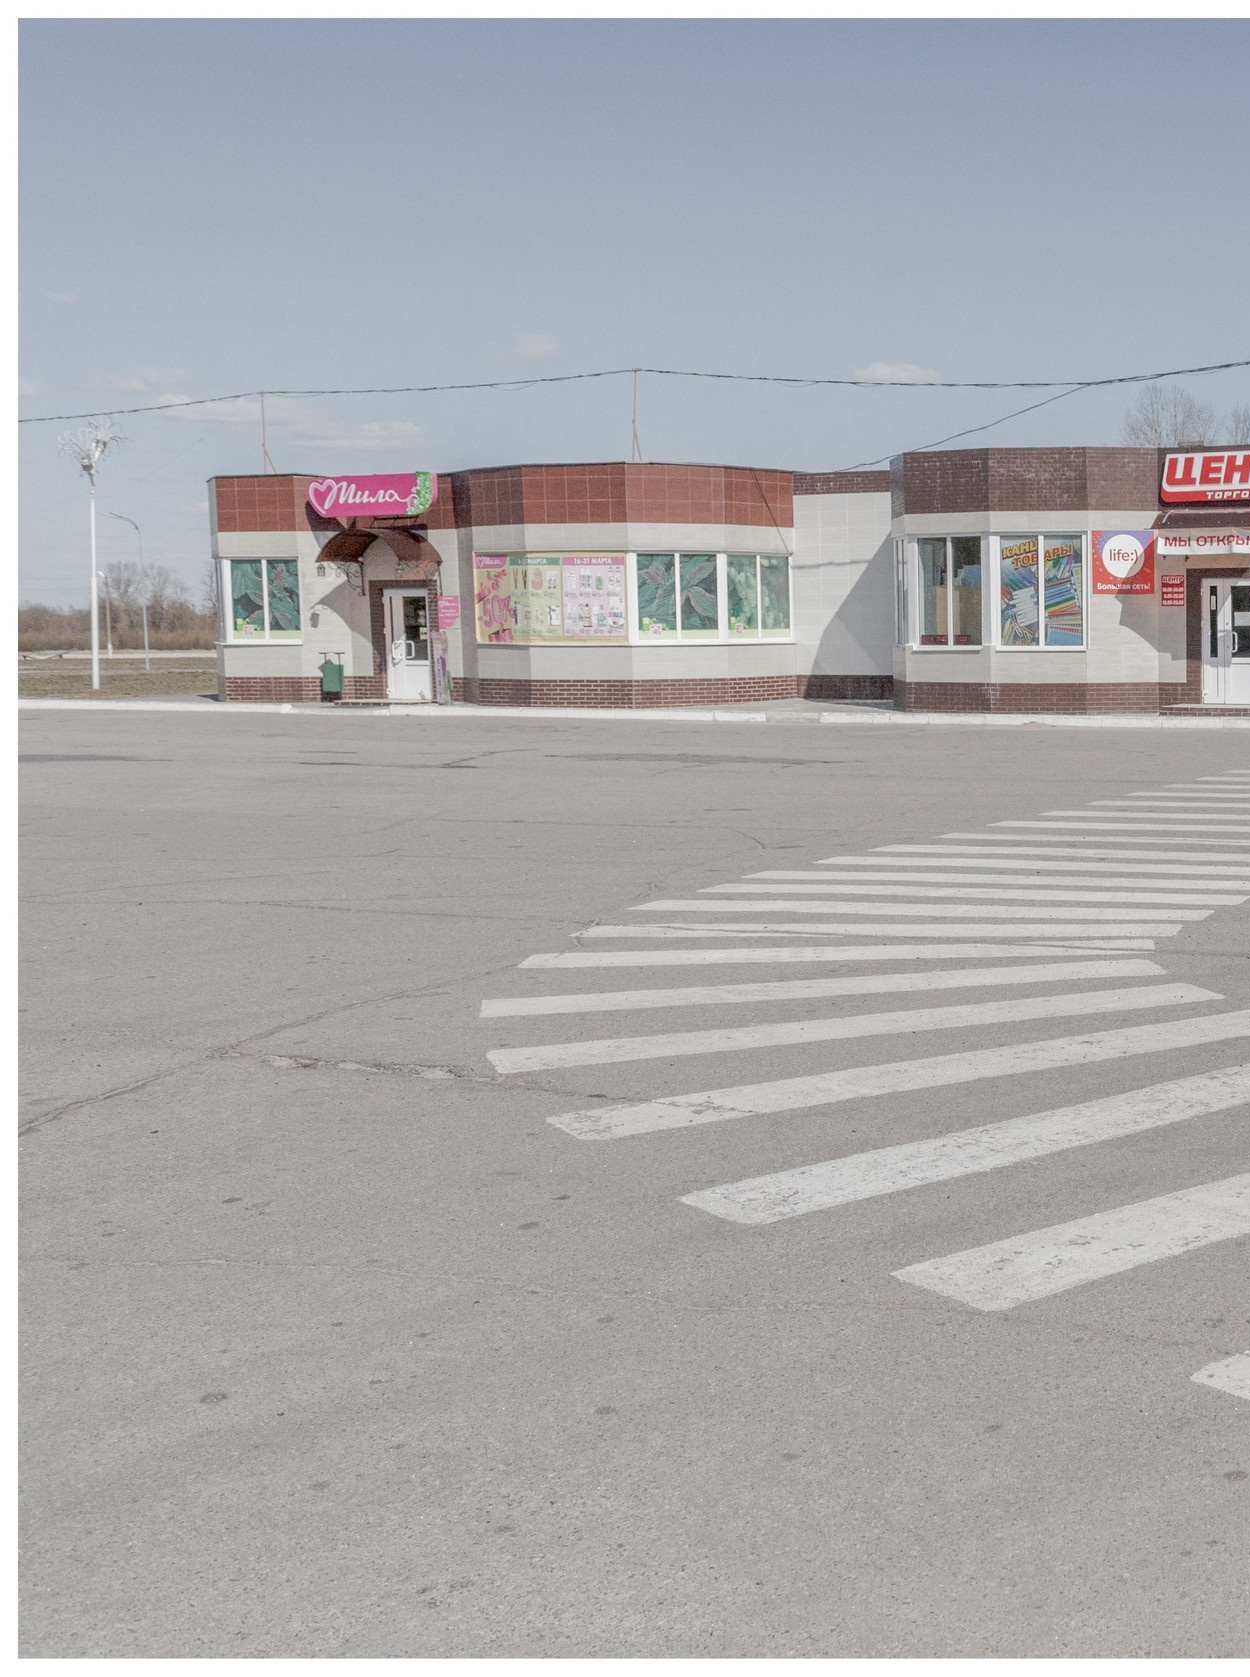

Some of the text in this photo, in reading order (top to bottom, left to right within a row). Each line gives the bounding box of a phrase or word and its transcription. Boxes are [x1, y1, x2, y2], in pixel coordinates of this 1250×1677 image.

[324, 477, 407, 510] Мила
[1164, 536, 1191, 547] МЫ
[1012, 544, 1073, 569] ТОВАРЫ
[1109, 549, 1139, 565] life:)
